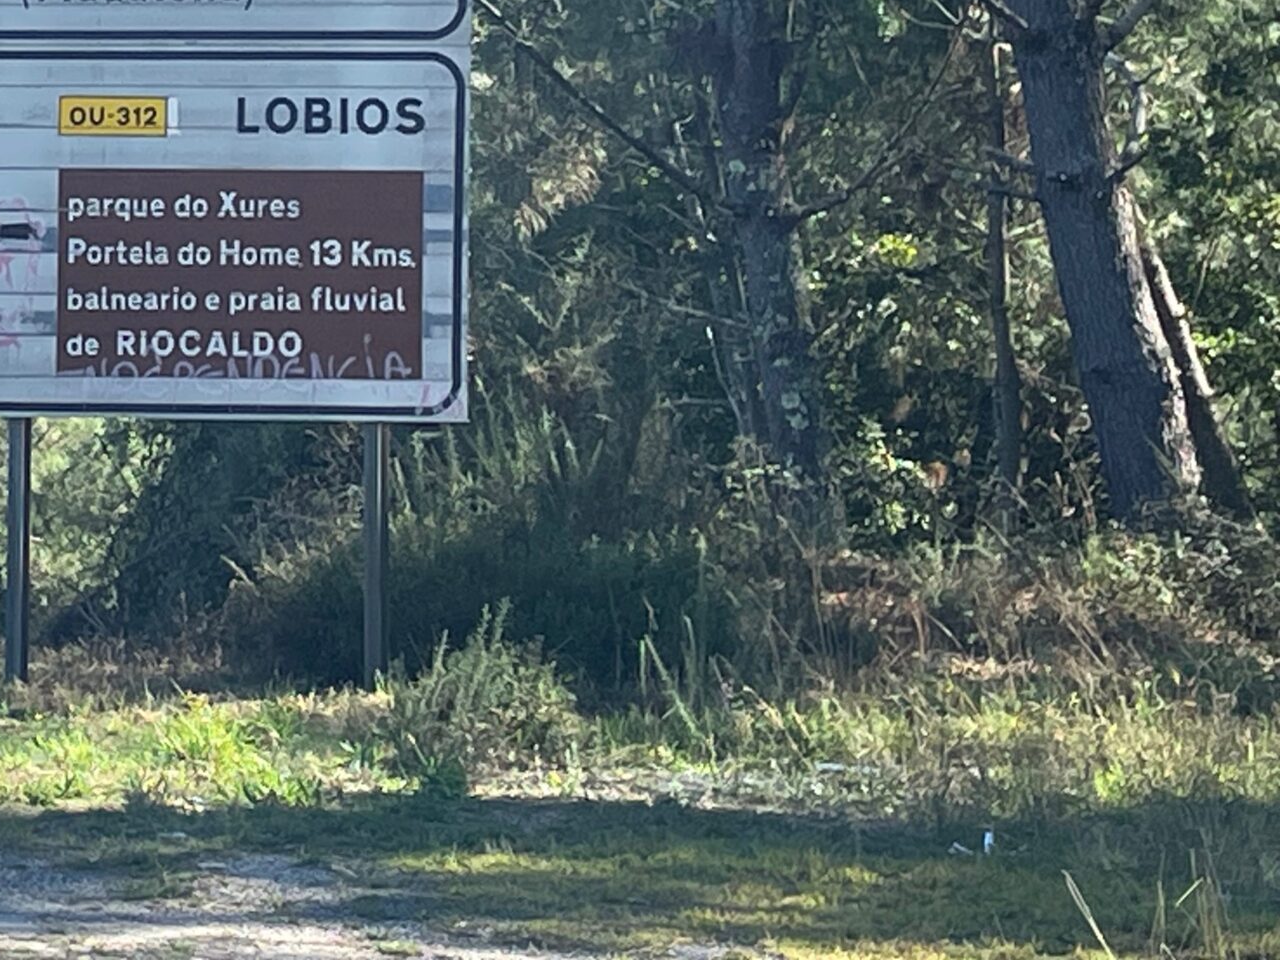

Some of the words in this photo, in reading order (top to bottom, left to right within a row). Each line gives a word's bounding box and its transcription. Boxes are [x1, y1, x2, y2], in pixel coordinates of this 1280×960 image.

[69, 106, 157, 127] OU-312
[236, 96, 426, 135] LOBIOS
[68, 197, 166, 222] parque
[174, 193, 209, 218] do
[217, 191, 300, 218] Xures
[67, 237, 170, 265] Portela
[177, 241, 211, 266] do
[309, 239, 342, 266] 13
[67, 286, 197, 311] balneario
[204, 293, 220, 311] e
[229, 286, 302, 316] praia
[311, 286, 406, 312] fluvial
[66, 333, 100, 356] de
[117, 329, 302, 360] RIOCALDO
